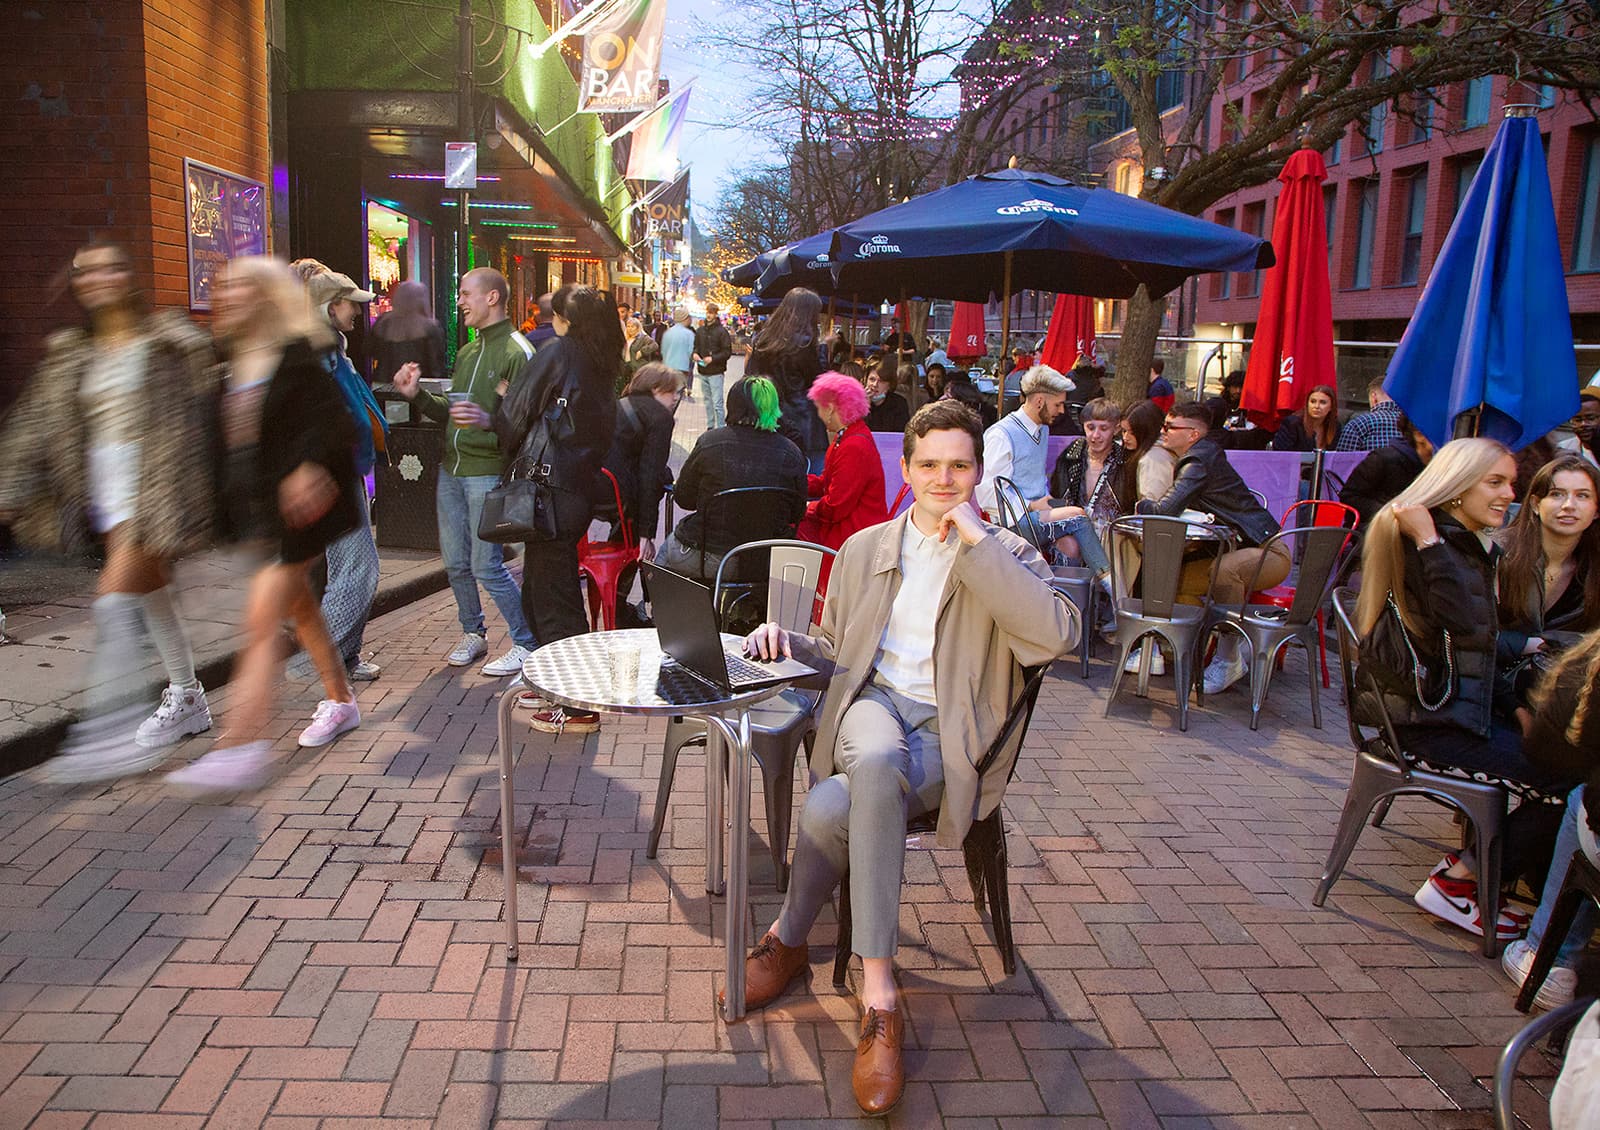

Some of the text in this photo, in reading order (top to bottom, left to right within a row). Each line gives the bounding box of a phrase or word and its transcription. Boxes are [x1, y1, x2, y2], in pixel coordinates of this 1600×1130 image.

[590, 32, 656, 71] ON
[588, 68, 654, 98] BAR
[650, 203, 682, 221] ON
[996, 205, 1080, 216] Corona
[649, 218, 682, 234] BAR
[855, 245, 902, 259] Corona
[807, 260, 833, 270] Coron
